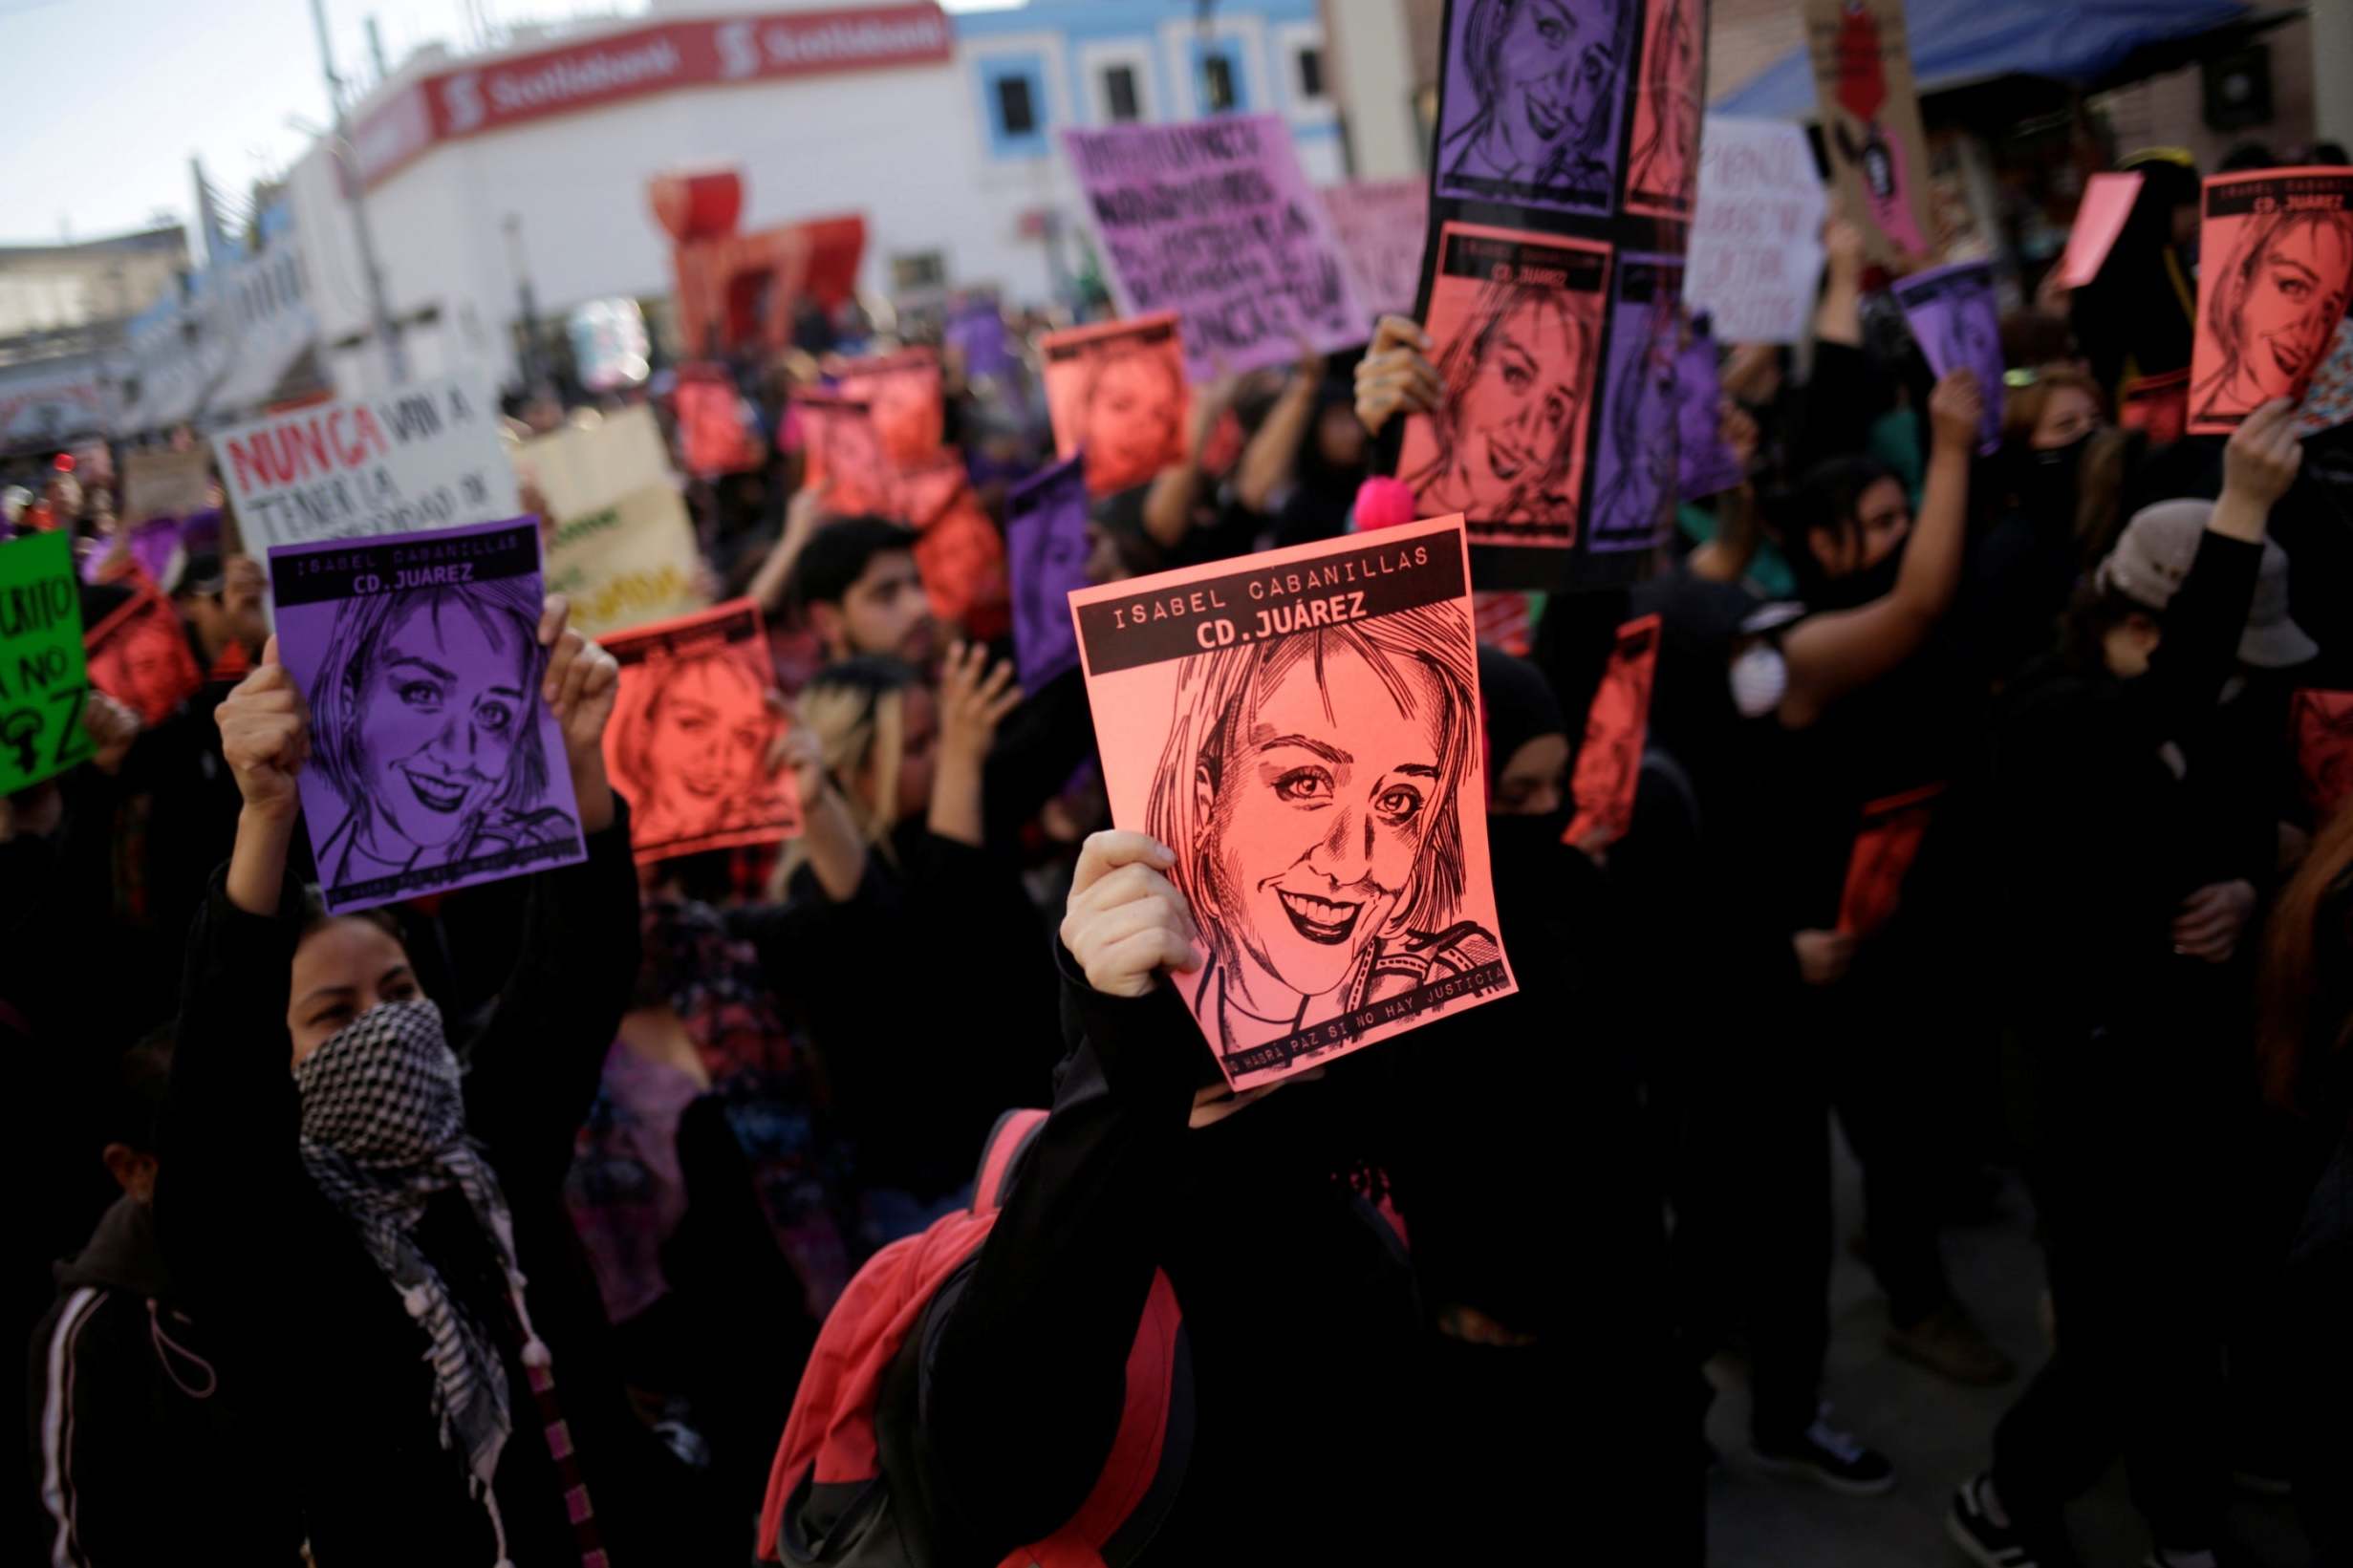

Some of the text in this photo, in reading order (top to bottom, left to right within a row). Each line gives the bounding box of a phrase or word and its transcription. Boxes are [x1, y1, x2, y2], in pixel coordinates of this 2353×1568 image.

[489, 40, 680, 113] Scotiabank
[767, 16, 939, 64] Scotiabank
[227, 403, 390, 495] NUNCA
[1113, 546, 1428, 630] ISABEL CABANILLAS
[1290, 1032, 1320, 1052] PAZ
[1328, 1022, 1348, 1039] SI
[1356, 1012, 1374, 1028] NO
[1385, 997, 1414, 1019] HAY
[1428, 965, 1505, 1003] JUSTICIA
